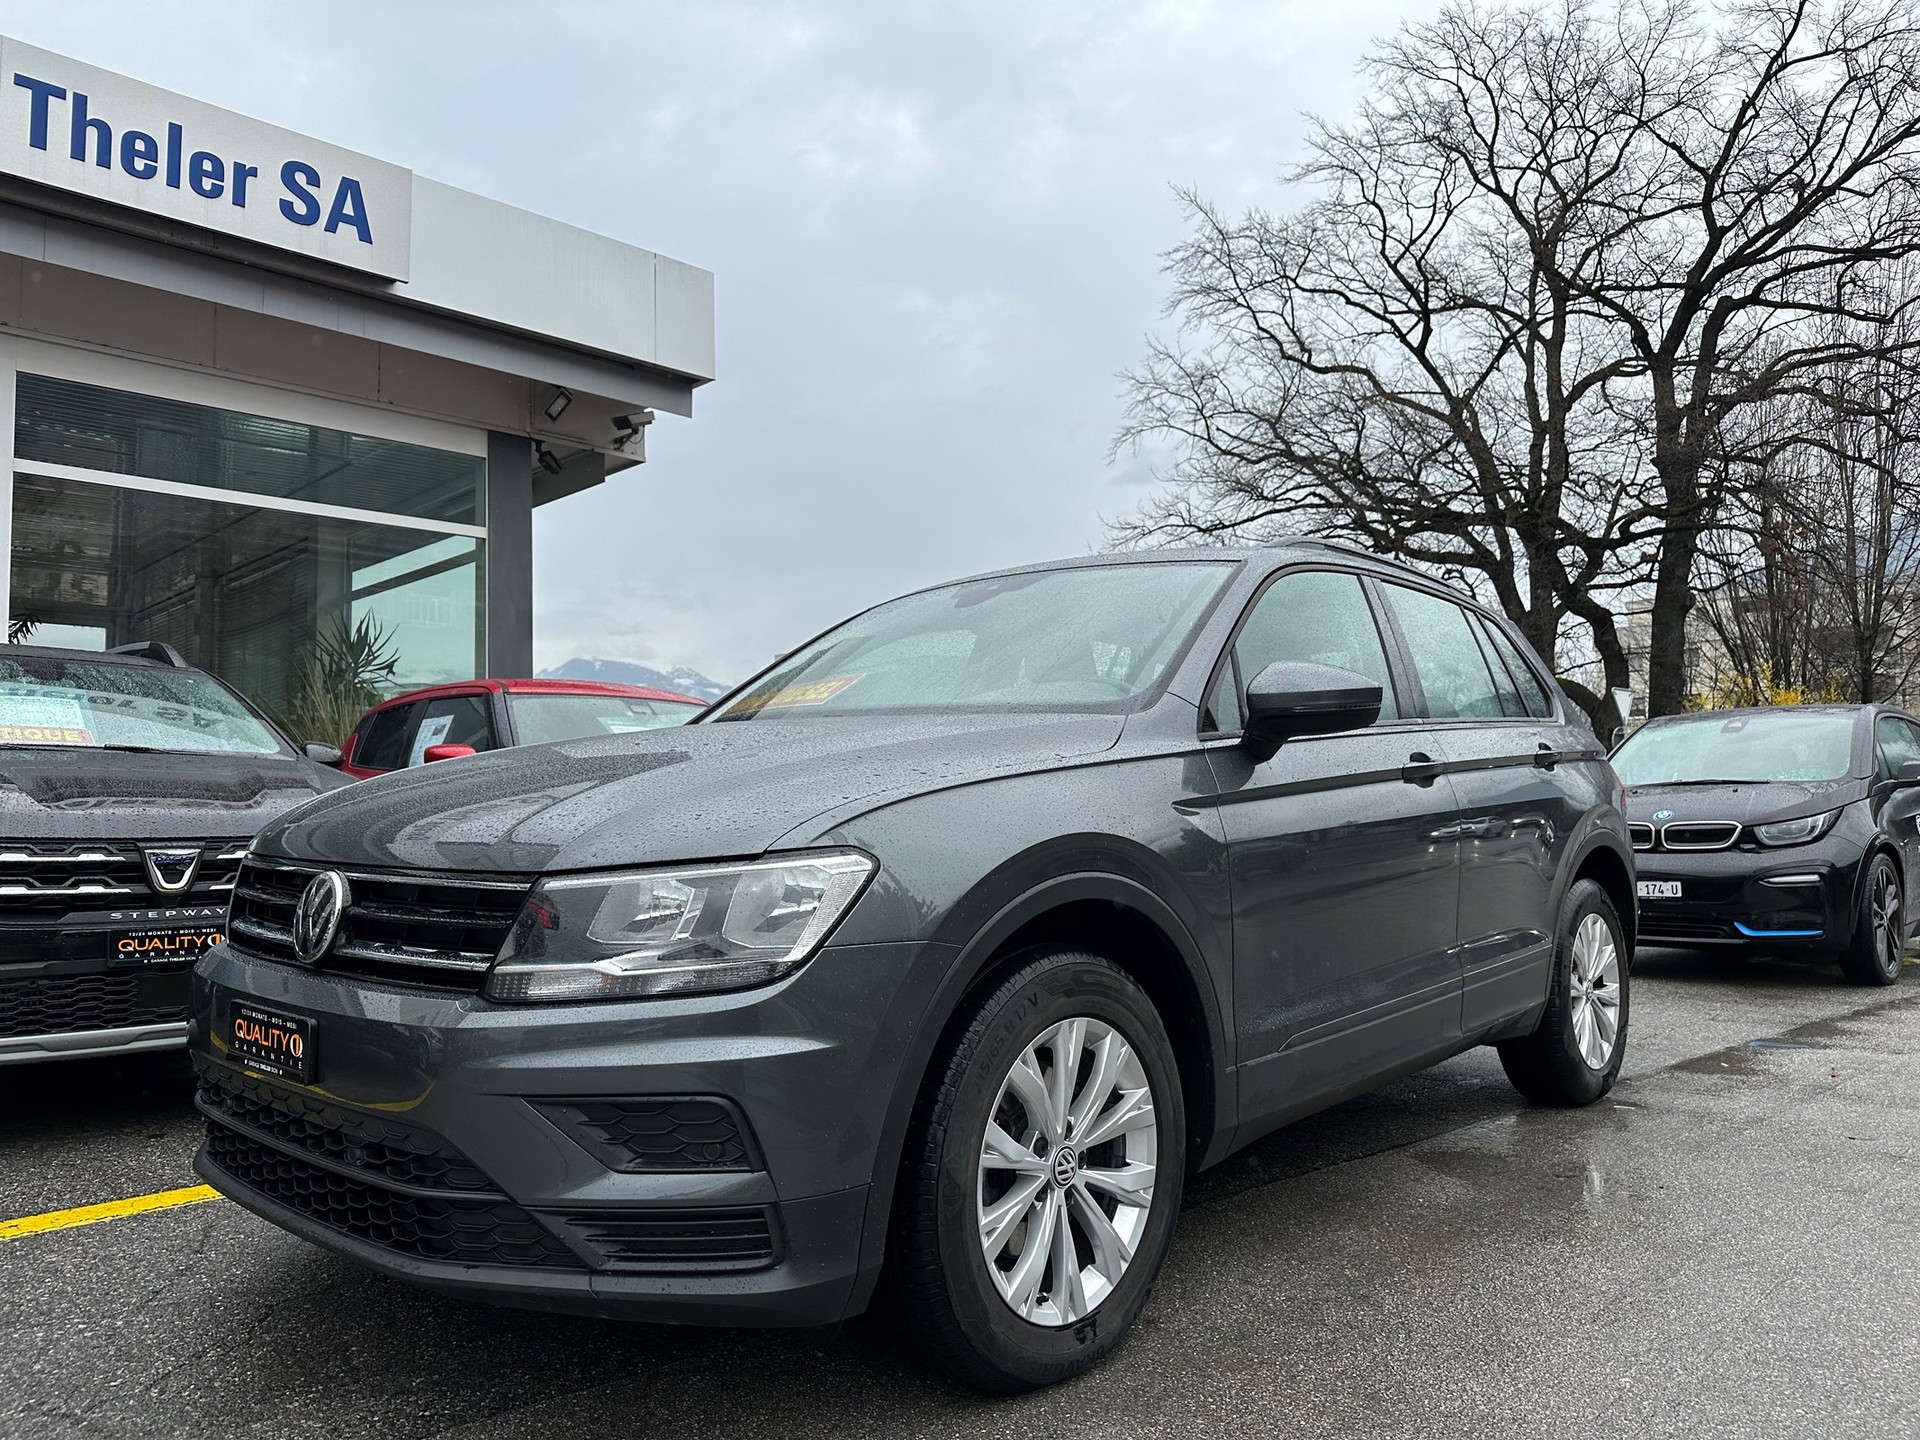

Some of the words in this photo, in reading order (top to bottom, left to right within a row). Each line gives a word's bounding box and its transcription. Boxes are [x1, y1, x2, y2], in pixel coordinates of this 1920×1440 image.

[14, 72, 258, 208] Theler
[279, 160, 373, 245] SA
[110, 907, 226, 919] STEPWAY
[118, 935, 205, 951] QUALITY
[119, 949, 199, 959] GARANT
[252, 1011, 268, 1021] MONATE
[271, 1017, 282, 1026] MOIS
[235, 1018, 289, 1051] QUALITY
[235, 1041, 302, 1069] GARANTIE
